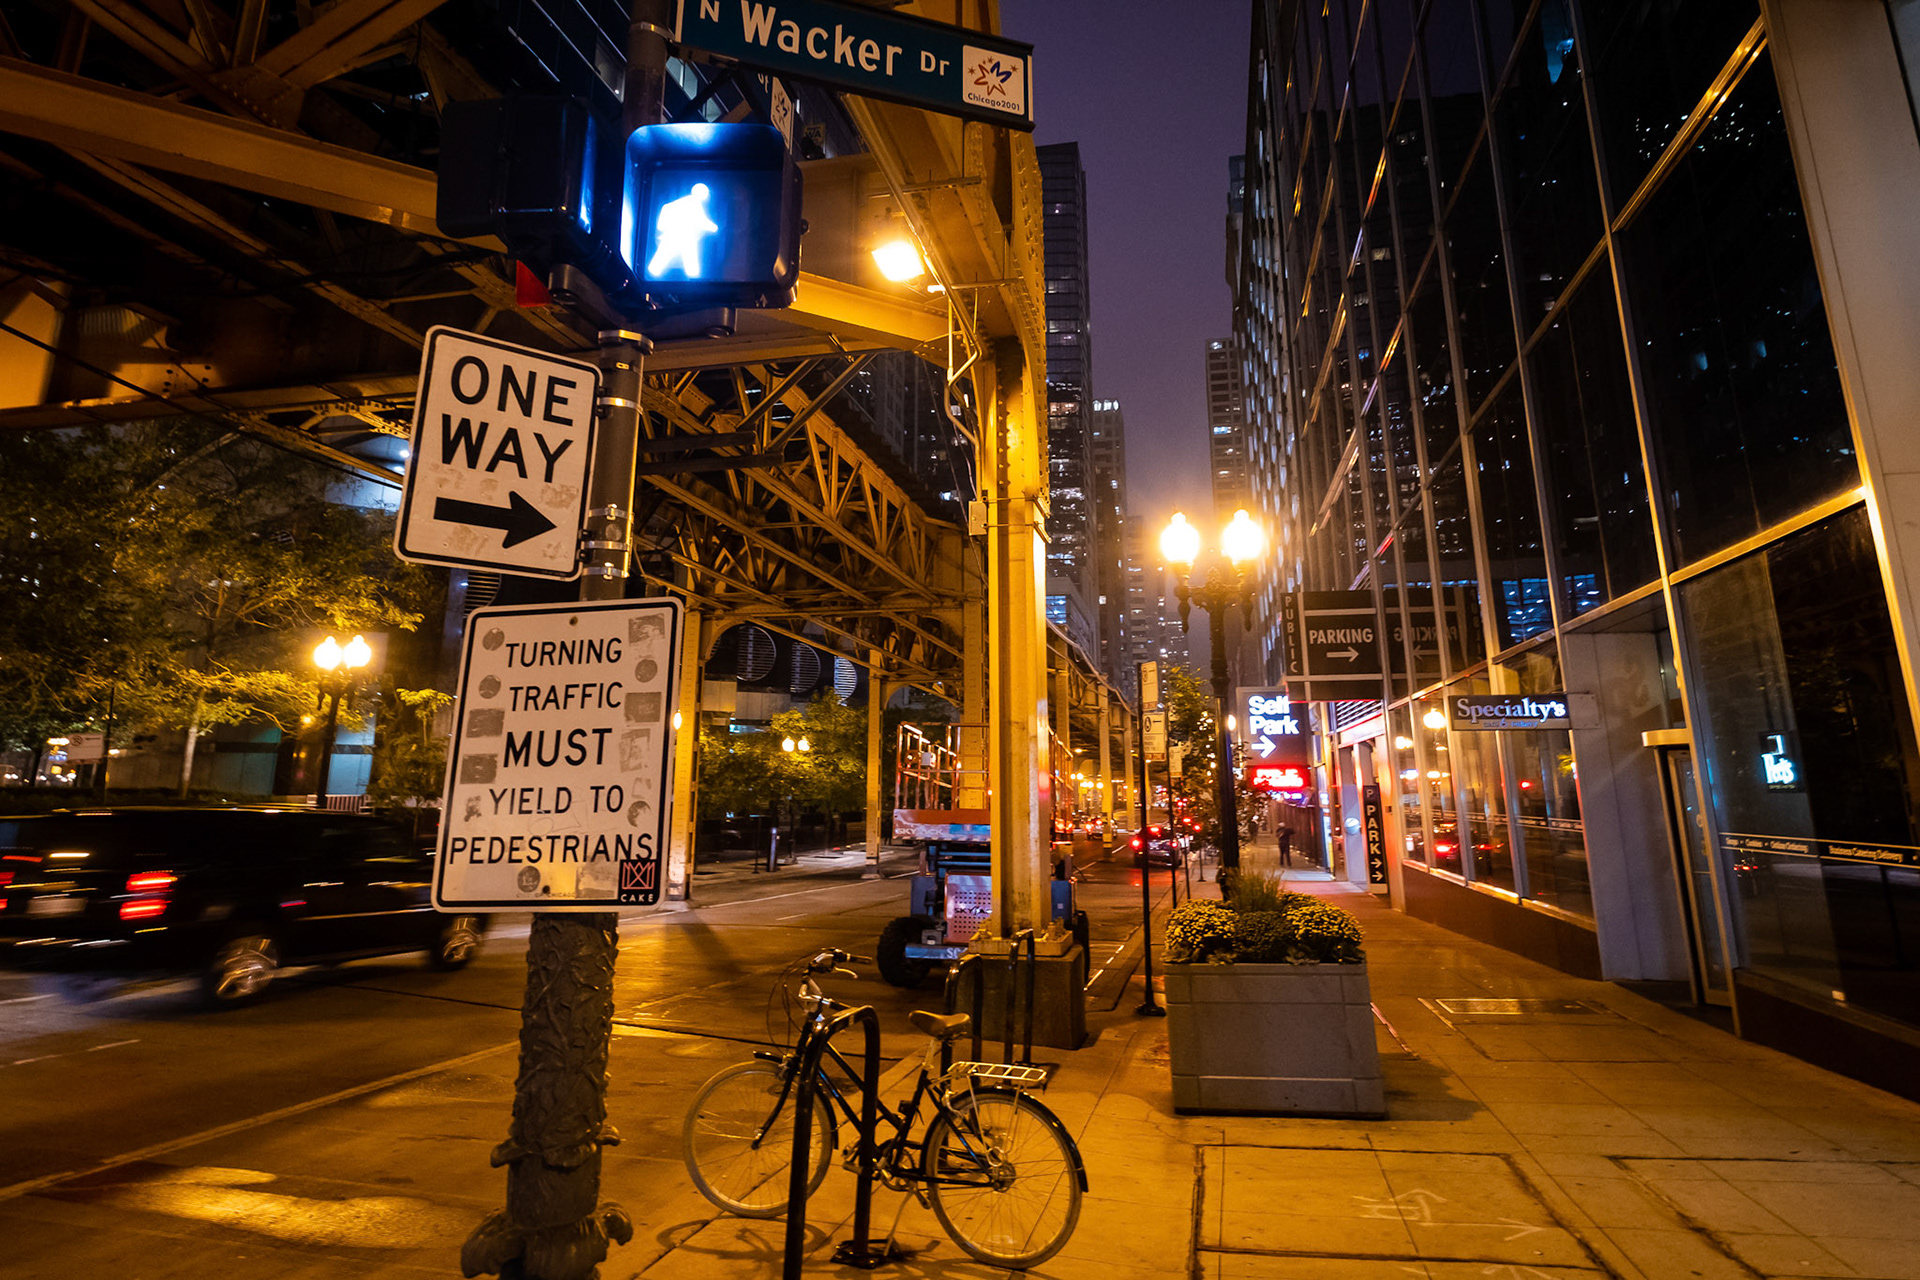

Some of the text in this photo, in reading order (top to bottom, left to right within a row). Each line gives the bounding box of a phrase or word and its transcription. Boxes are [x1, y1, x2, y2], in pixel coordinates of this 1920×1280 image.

[699, 0, 950, 76] N Wacker Dr
[967, 92, 1020, 111] Chicago2001
[451, 355, 577, 427] ONE
[441, 413, 574, 483] WAY
[1284, 595, 1298, 673] PUBLIC
[1309, 628, 1374, 644] PARKING
[505, 637, 622, 668] TURNING
[509, 682, 623, 712] TRAFFIC
[1248, 695, 1290, 715] Self
[1457, 697, 1566, 723] Specialty's
[1250, 715, 1299, 735] Park
[502, 728, 613, 768] MUST
[488, 784, 624, 815] YIELD TO
[1366, 805, 1381, 855] PARK
[449, 833, 653, 865] PEDESTRIANS
[620, 893, 654, 902] CAKE
